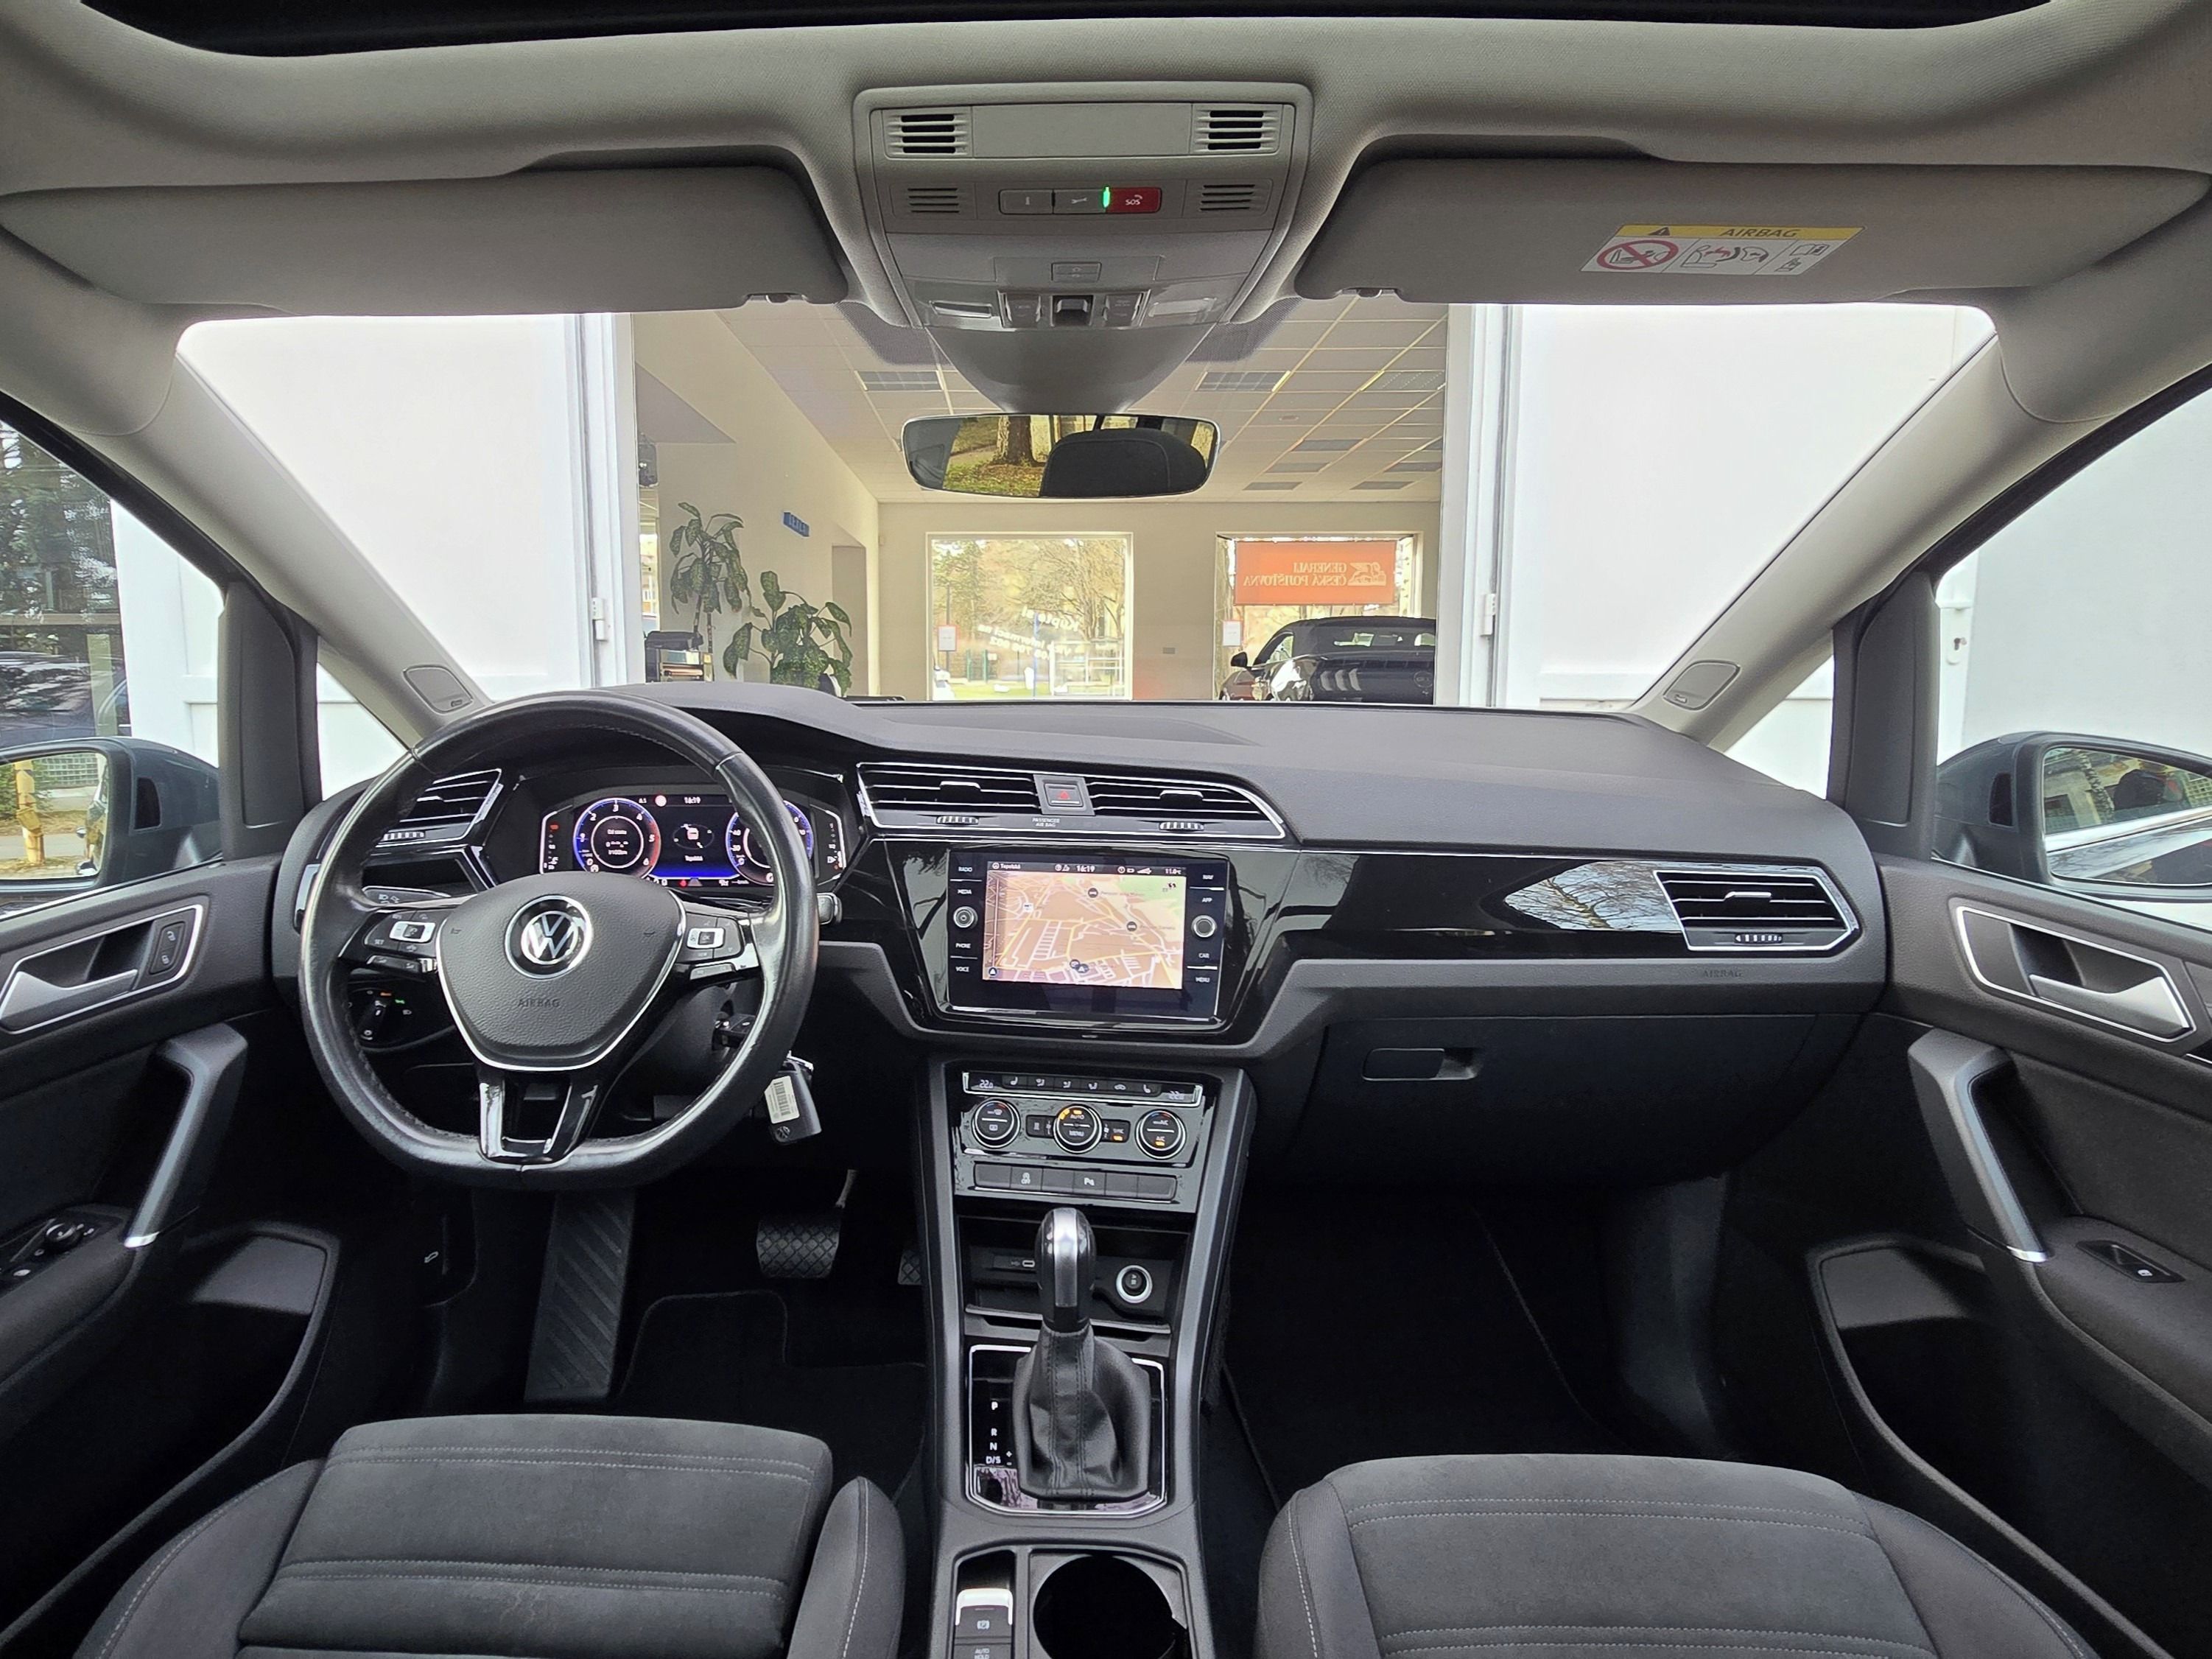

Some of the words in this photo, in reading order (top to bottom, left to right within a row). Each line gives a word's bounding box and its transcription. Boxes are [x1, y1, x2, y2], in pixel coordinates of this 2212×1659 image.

[1719, 228, 1800, 238] AIRBAG
[1076, 865, 1095, 873] 16:19
[518, 998, 561, 1008] AIRBAG
[991, 1401, 998, 1410] P
[991, 1428, 997, 1437] R
[989, 1442, 997, 1451] N
[986, 1456, 1001, 1465] D/S
